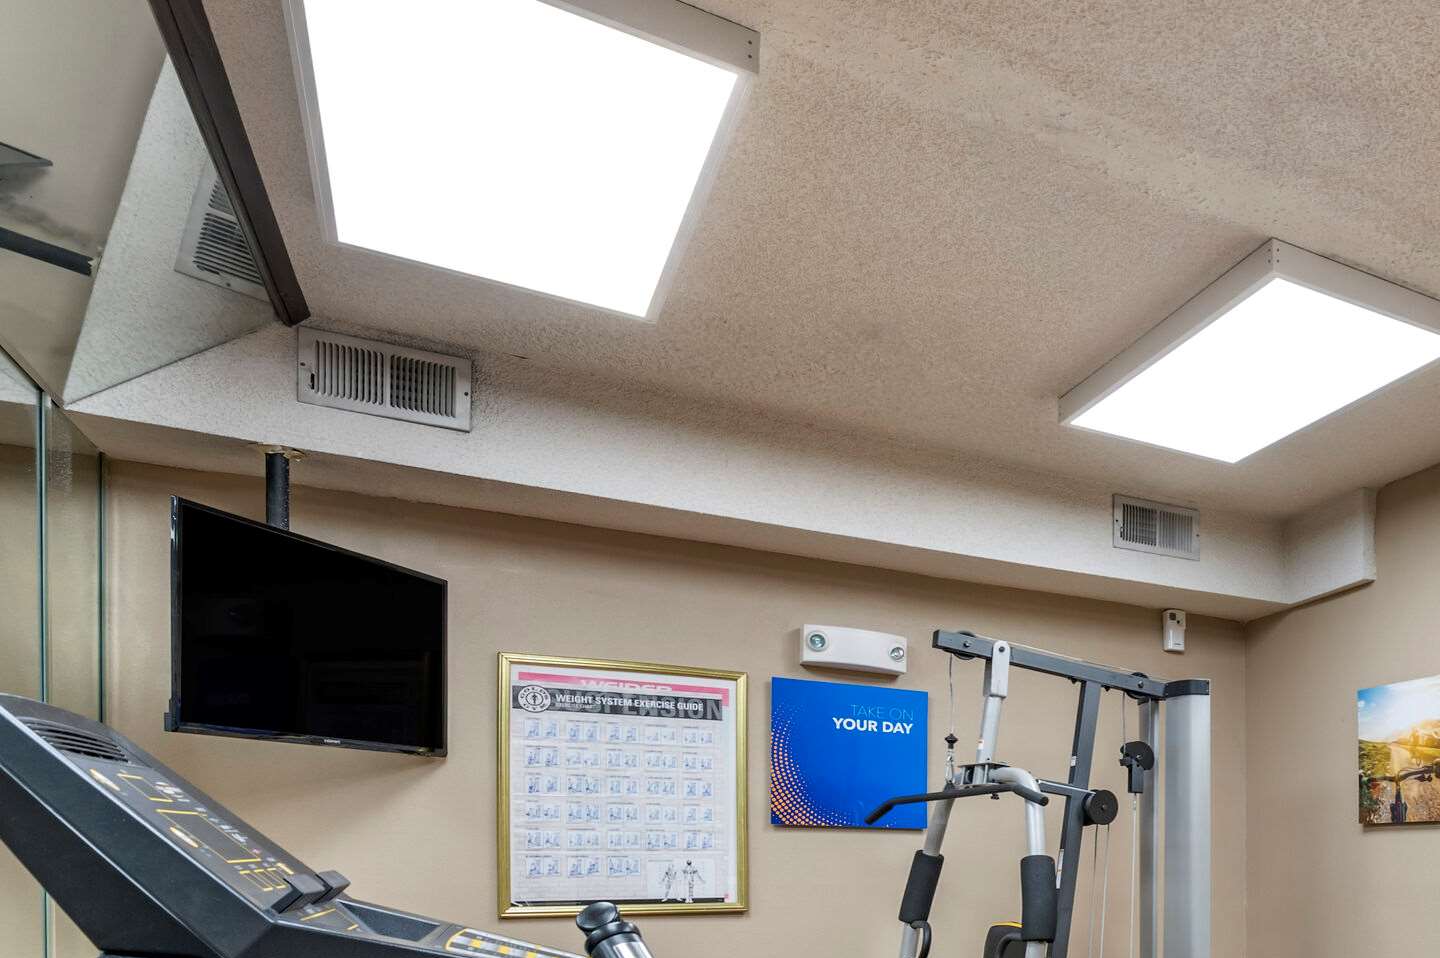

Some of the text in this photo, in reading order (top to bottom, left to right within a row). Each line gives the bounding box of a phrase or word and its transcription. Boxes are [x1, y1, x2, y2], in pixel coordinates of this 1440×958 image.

[555, 693, 594, 704] WEIGHT
[595, 696, 633, 707] SYSTEM
[634, 699, 676, 709] EXERCISE
[677, 702, 704, 711] GUIDE
[850, 704, 914, 721] TAKE ON
[832, 717, 914, 734] YOUR DAY
